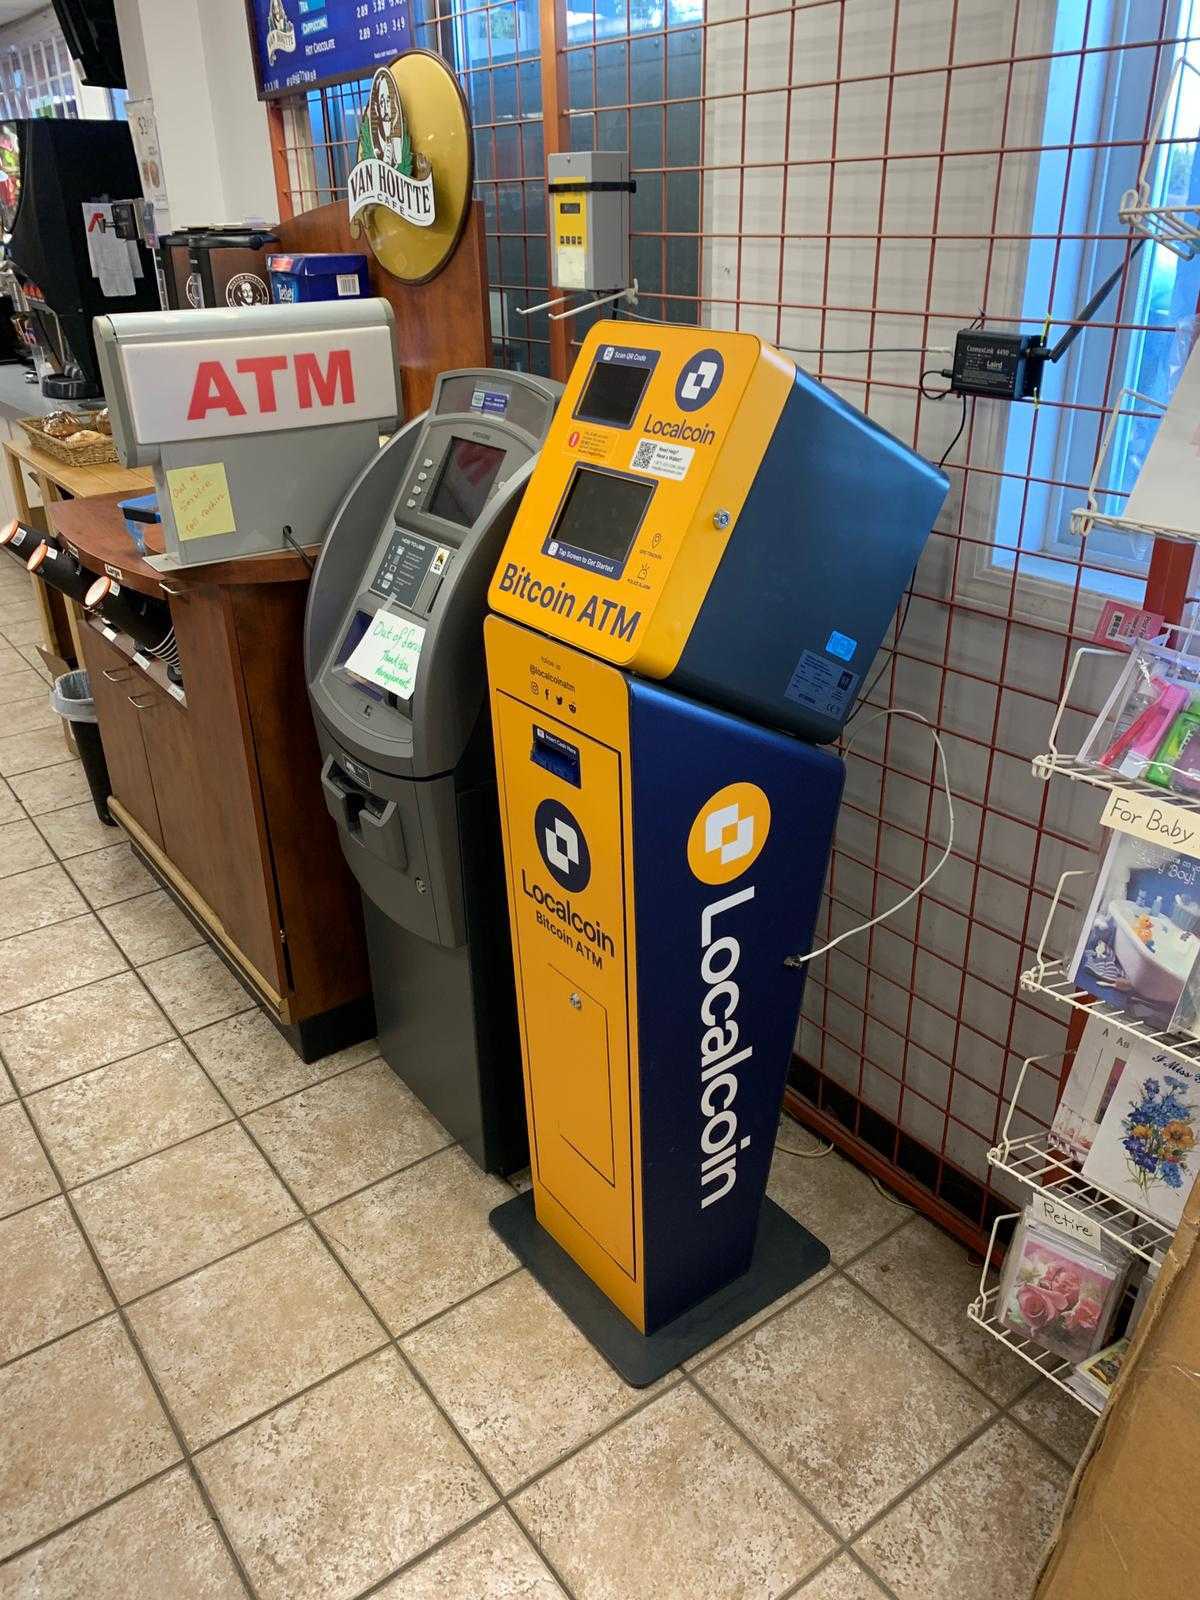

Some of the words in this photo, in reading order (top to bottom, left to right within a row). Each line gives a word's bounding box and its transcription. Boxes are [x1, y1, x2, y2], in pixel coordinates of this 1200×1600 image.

[350, 163, 374, 202] VAN
[378, 164, 431, 214] HOUTTE
[614, 351, 626, 360] Scan
[634, 353, 647, 362] Code
[187, 350, 356, 421] ATM
[643, 414, 716, 445] Localcoin
[558, 547, 567, 557] Tap
[567, 550, 581, 562] Screen
[587, 557, 596, 568] Get
[596, 559, 615, 573] Started
[498, 562, 576, 618] Bitcoin
[576, 594, 642, 643] ATM
[529, 664, 576, 693] @localcoinatm
[1110, 797, 1142, 824] For
[1146, 808, 1195, 845] Baby
[521, 867, 616, 959] Localcoin
[535, 909, 574, 950] Bitcoin
[575, 940, 604, 971] ATM
[700, 885, 755, 1210] Localcoin
[1163, 1061, 1194, 1079] Miss
[1043, 1202, 1094, 1238] Retire
